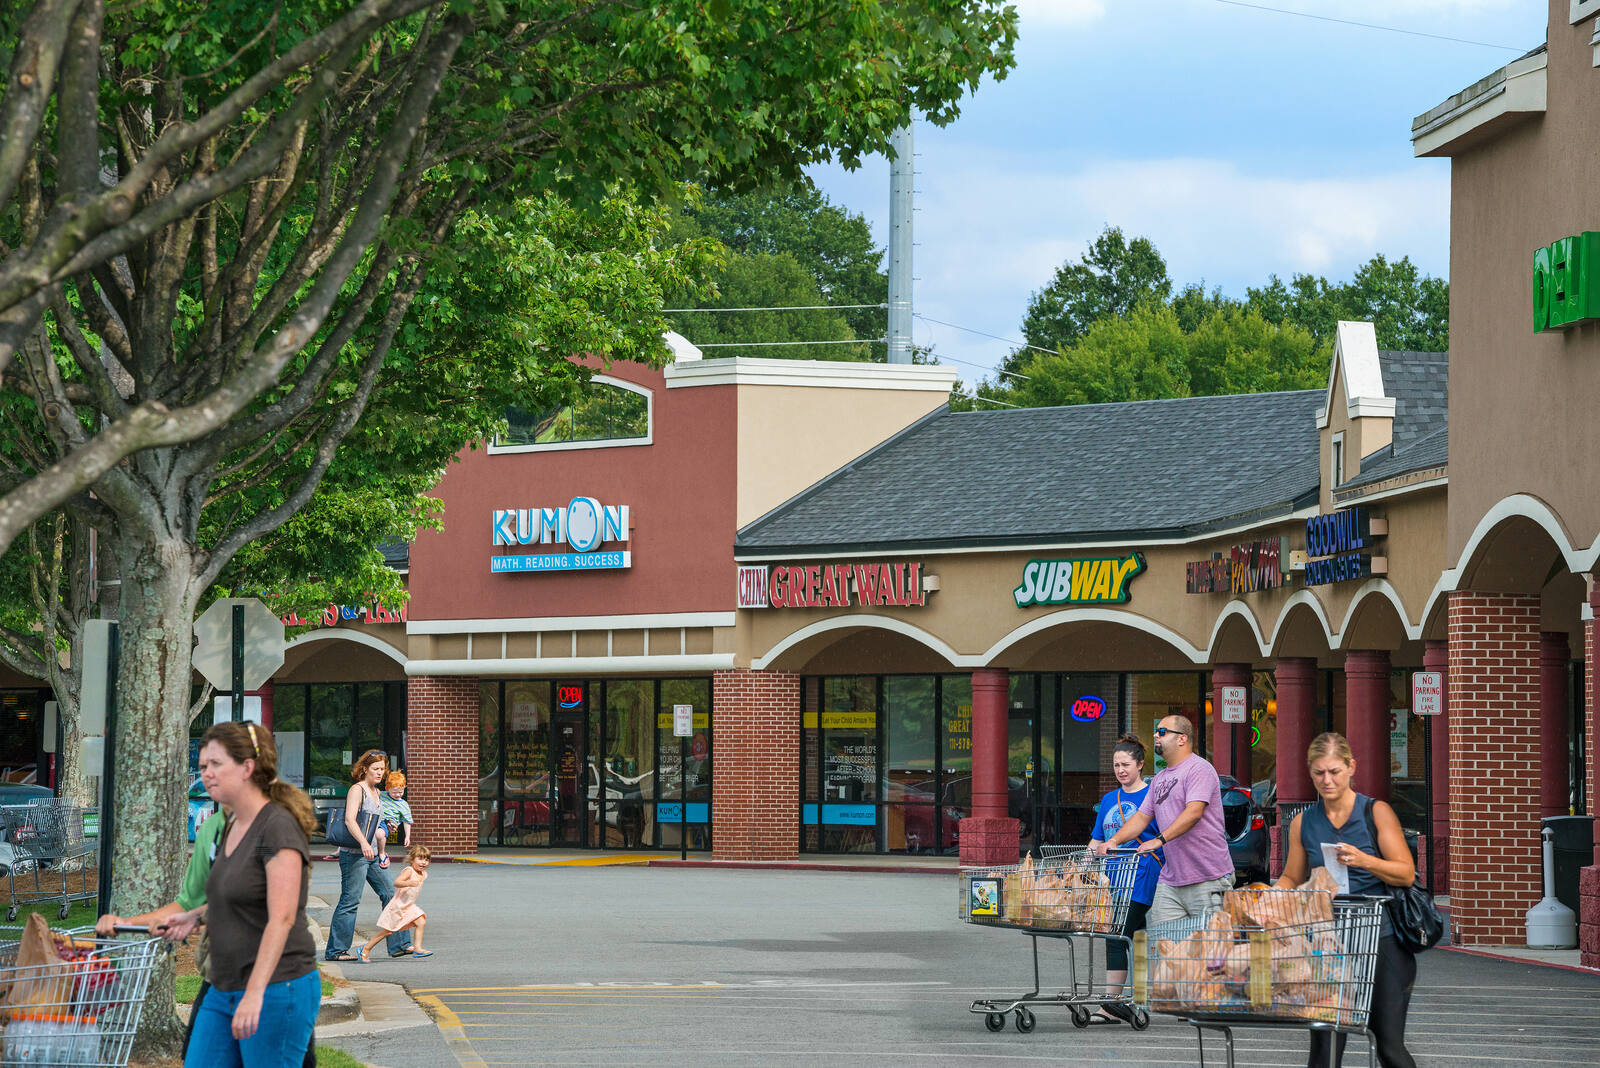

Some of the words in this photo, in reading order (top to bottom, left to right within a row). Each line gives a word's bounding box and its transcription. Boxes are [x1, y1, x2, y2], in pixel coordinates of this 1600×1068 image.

[493, 497, 630, 552] KUMON
[1306, 507, 1363, 557] GOODWILL
[493, 559, 523, 570] MATH.
[526, 557, 571, 567] READING.
[574, 554, 623, 567] SUCCESS.
[739, 568, 768, 606] CHINA
[769, 565, 851, 608] GREAT
[853, 562, 926, 607] WALL
[1014, 555, 1139, 605] SUBWAY
[1422, 676, 1433, 685] NO
[560, 686, 582, 702] OPEN
[1230, 690, 1239, 698] NO
[1415, 686, 1440, 695] PARKING
[1072, 699, 1103, 719] OPEN
[1224, 698, 1245, 706] PARKING
[948, 719, 970, 733] GREAT
[843, 745, 854, 754] THE
[308, 788, 331, 796] LEATHER
[331, 788, 336, 796] &
